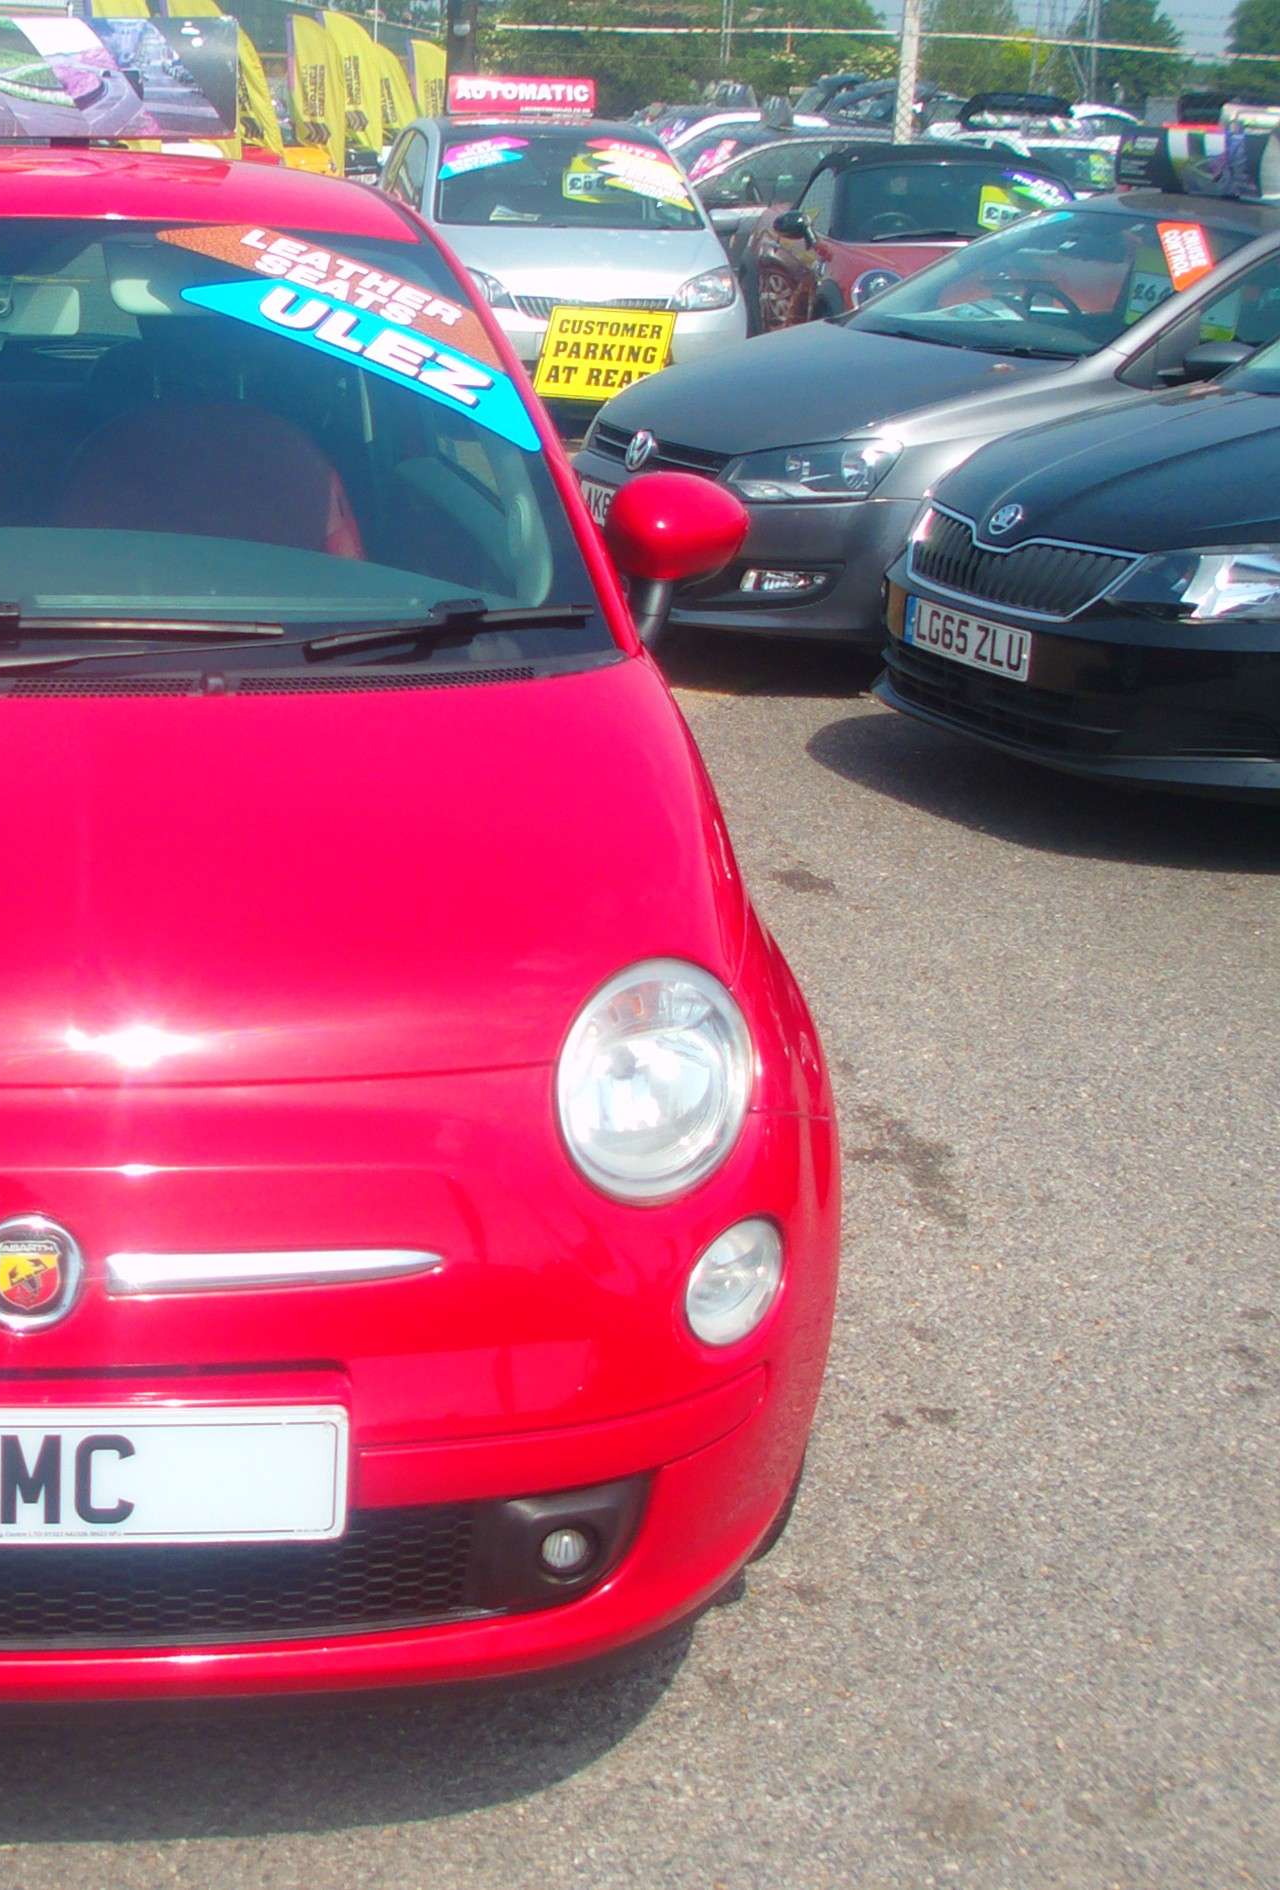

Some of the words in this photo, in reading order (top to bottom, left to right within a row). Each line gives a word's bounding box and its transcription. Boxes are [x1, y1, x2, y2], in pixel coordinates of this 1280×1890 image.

[456, 77, 589, 101] AUTOMATIC
[240, 229, 463, 326] LEATHER
[254, 253, 417, 326] SEATS
[259, 286, 495, 410] ULEZ
[553, 340, 658, 364] PARKING
[558, 319, 663, 340] CUSTOMER
[545, 365, 578, 385] AT
[915, 604, 970, 655] LG65
[973, 624, 1024, 672] ZLU
